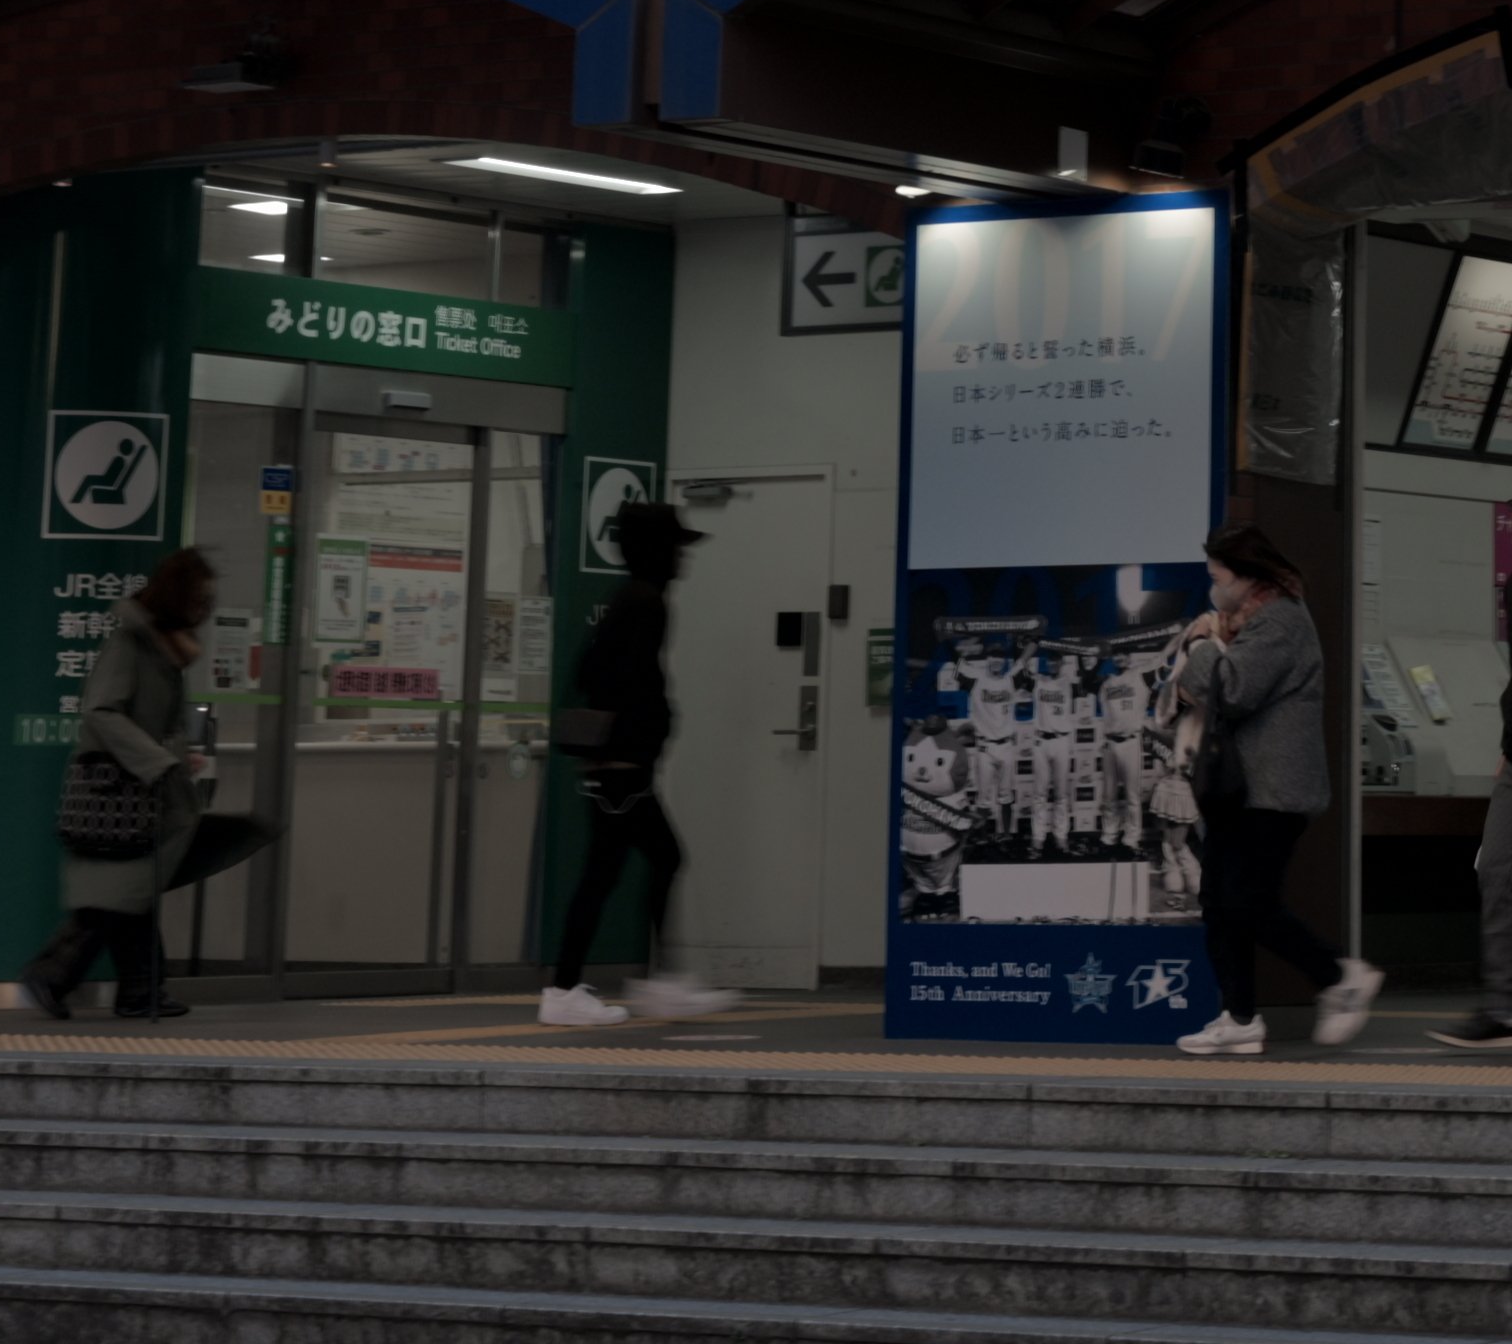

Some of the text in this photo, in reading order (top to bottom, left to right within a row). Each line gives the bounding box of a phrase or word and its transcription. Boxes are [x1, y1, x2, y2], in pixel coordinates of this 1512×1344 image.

[265, 297, 428, 348] みどりの窓口
[434, 330, 521, 360] Ticket Office
[57, 610, 122, 639] 新幹
[909, 961, 1052, 979] Thanks, and We Go!
[909, 985, 945, 1002] 15th
[951, 985, 1052, 1005] Anniversary
